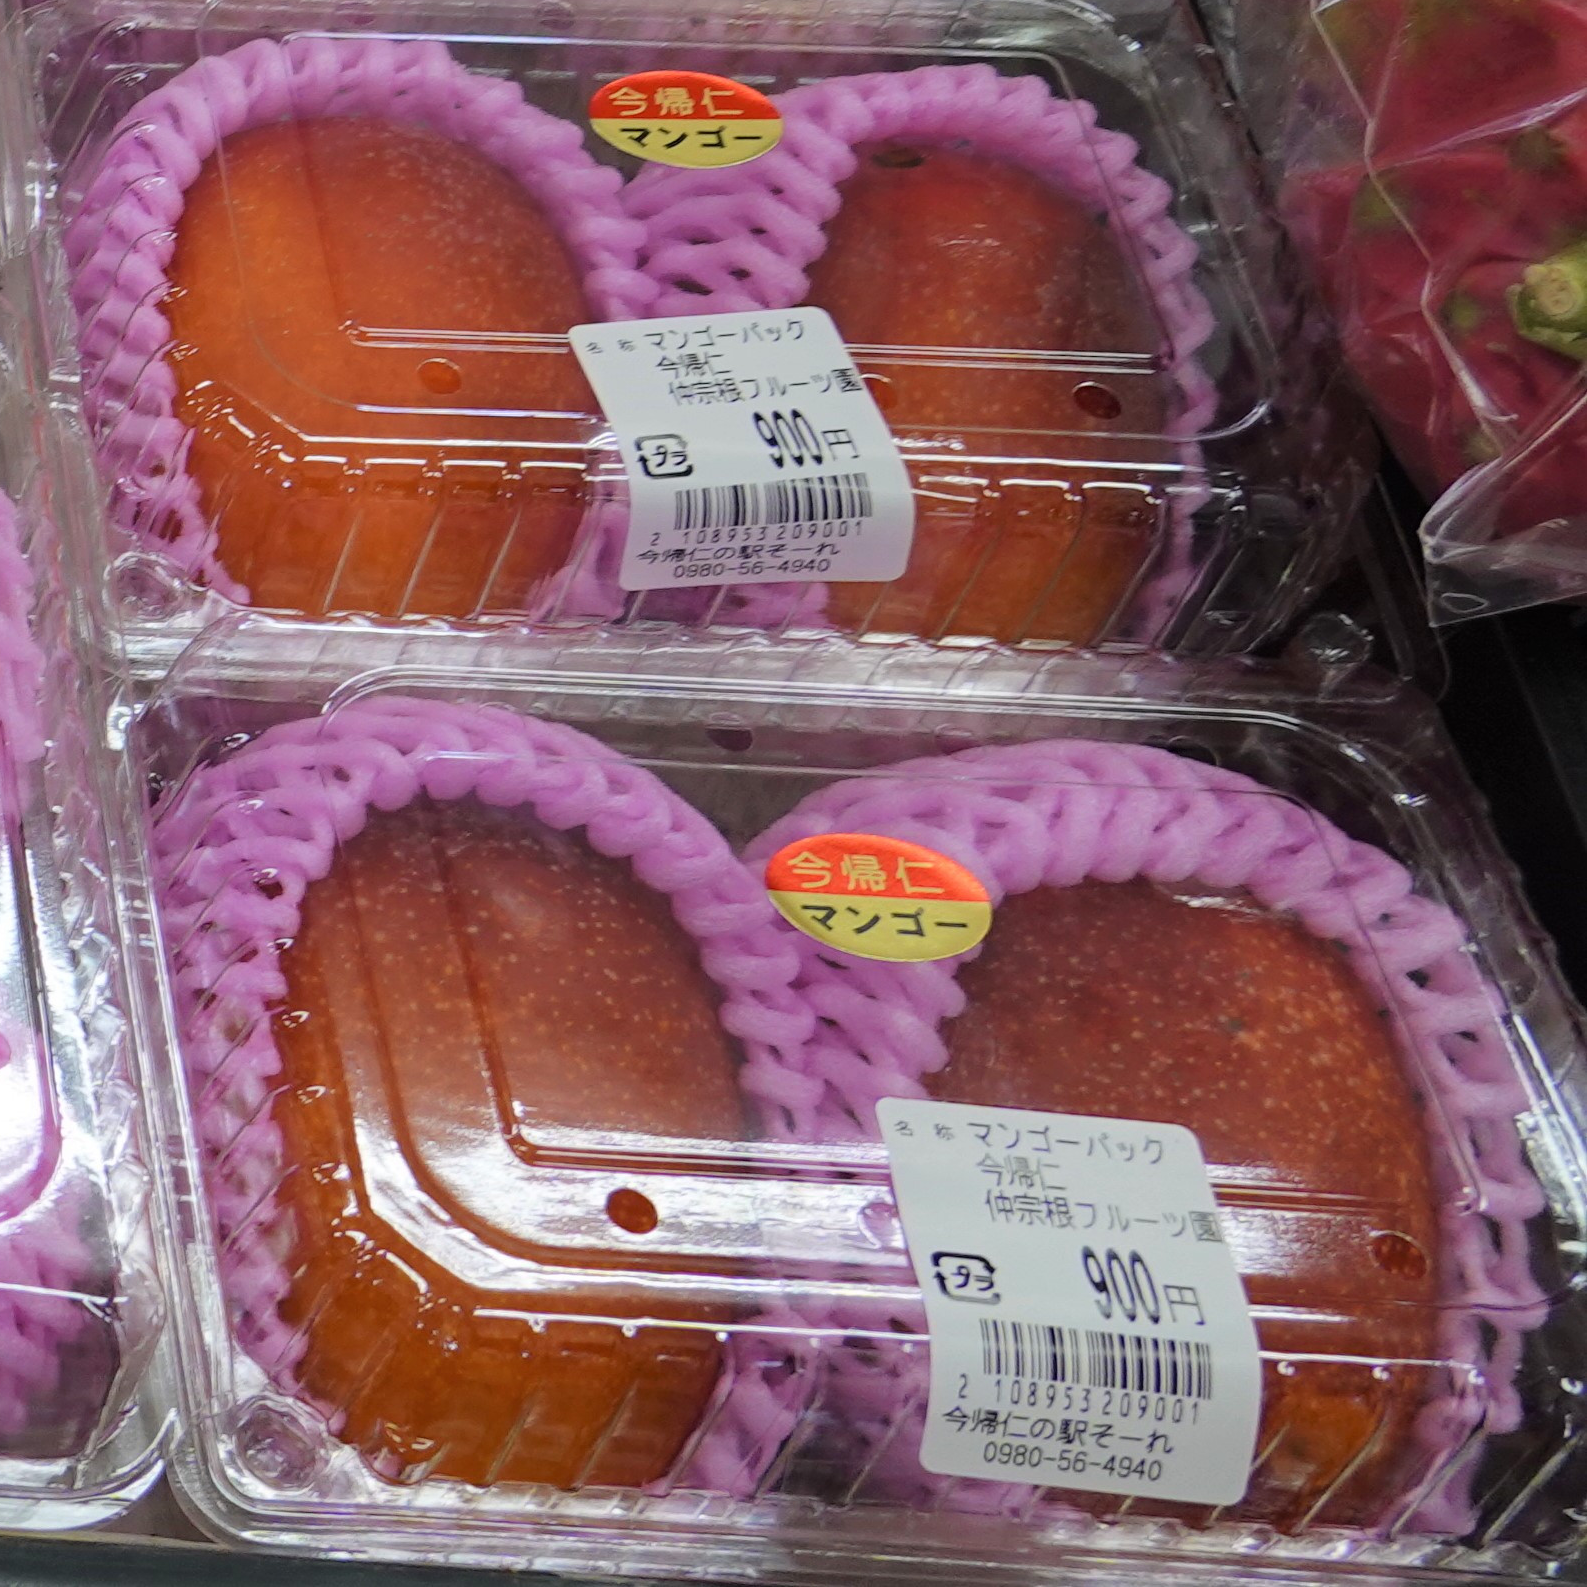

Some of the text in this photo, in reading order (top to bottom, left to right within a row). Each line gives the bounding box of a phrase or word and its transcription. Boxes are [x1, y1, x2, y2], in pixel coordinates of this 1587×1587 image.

[608, 87, 745, 117] 今帰仁
[619, 125, 763, 148] マンゴー
[643, 319, 807, 352] マンゴーパック
[655, 352, 732, 379] 今帰仁
[752, 408, 861, 471] 900円
[673, 557, 831, 579] 0980-56-4940
[787, 849, 945, 896] 今帰仁
[800, 902, 969, 938] マンゴー
[966, 1119, 1165, 1166] マンゴーパック
[975, 1152, 1067, 1193] 今帰仁
[983, 1193, 1223, 1245] 仲宗根フルーツ園
[1081, 1245, 1205, 1329] 900円
[943, 1405, 1175, 1456] 今帰仁の駅そーれ
[982, 1440, 1162, 1482] 0980-56-4940
